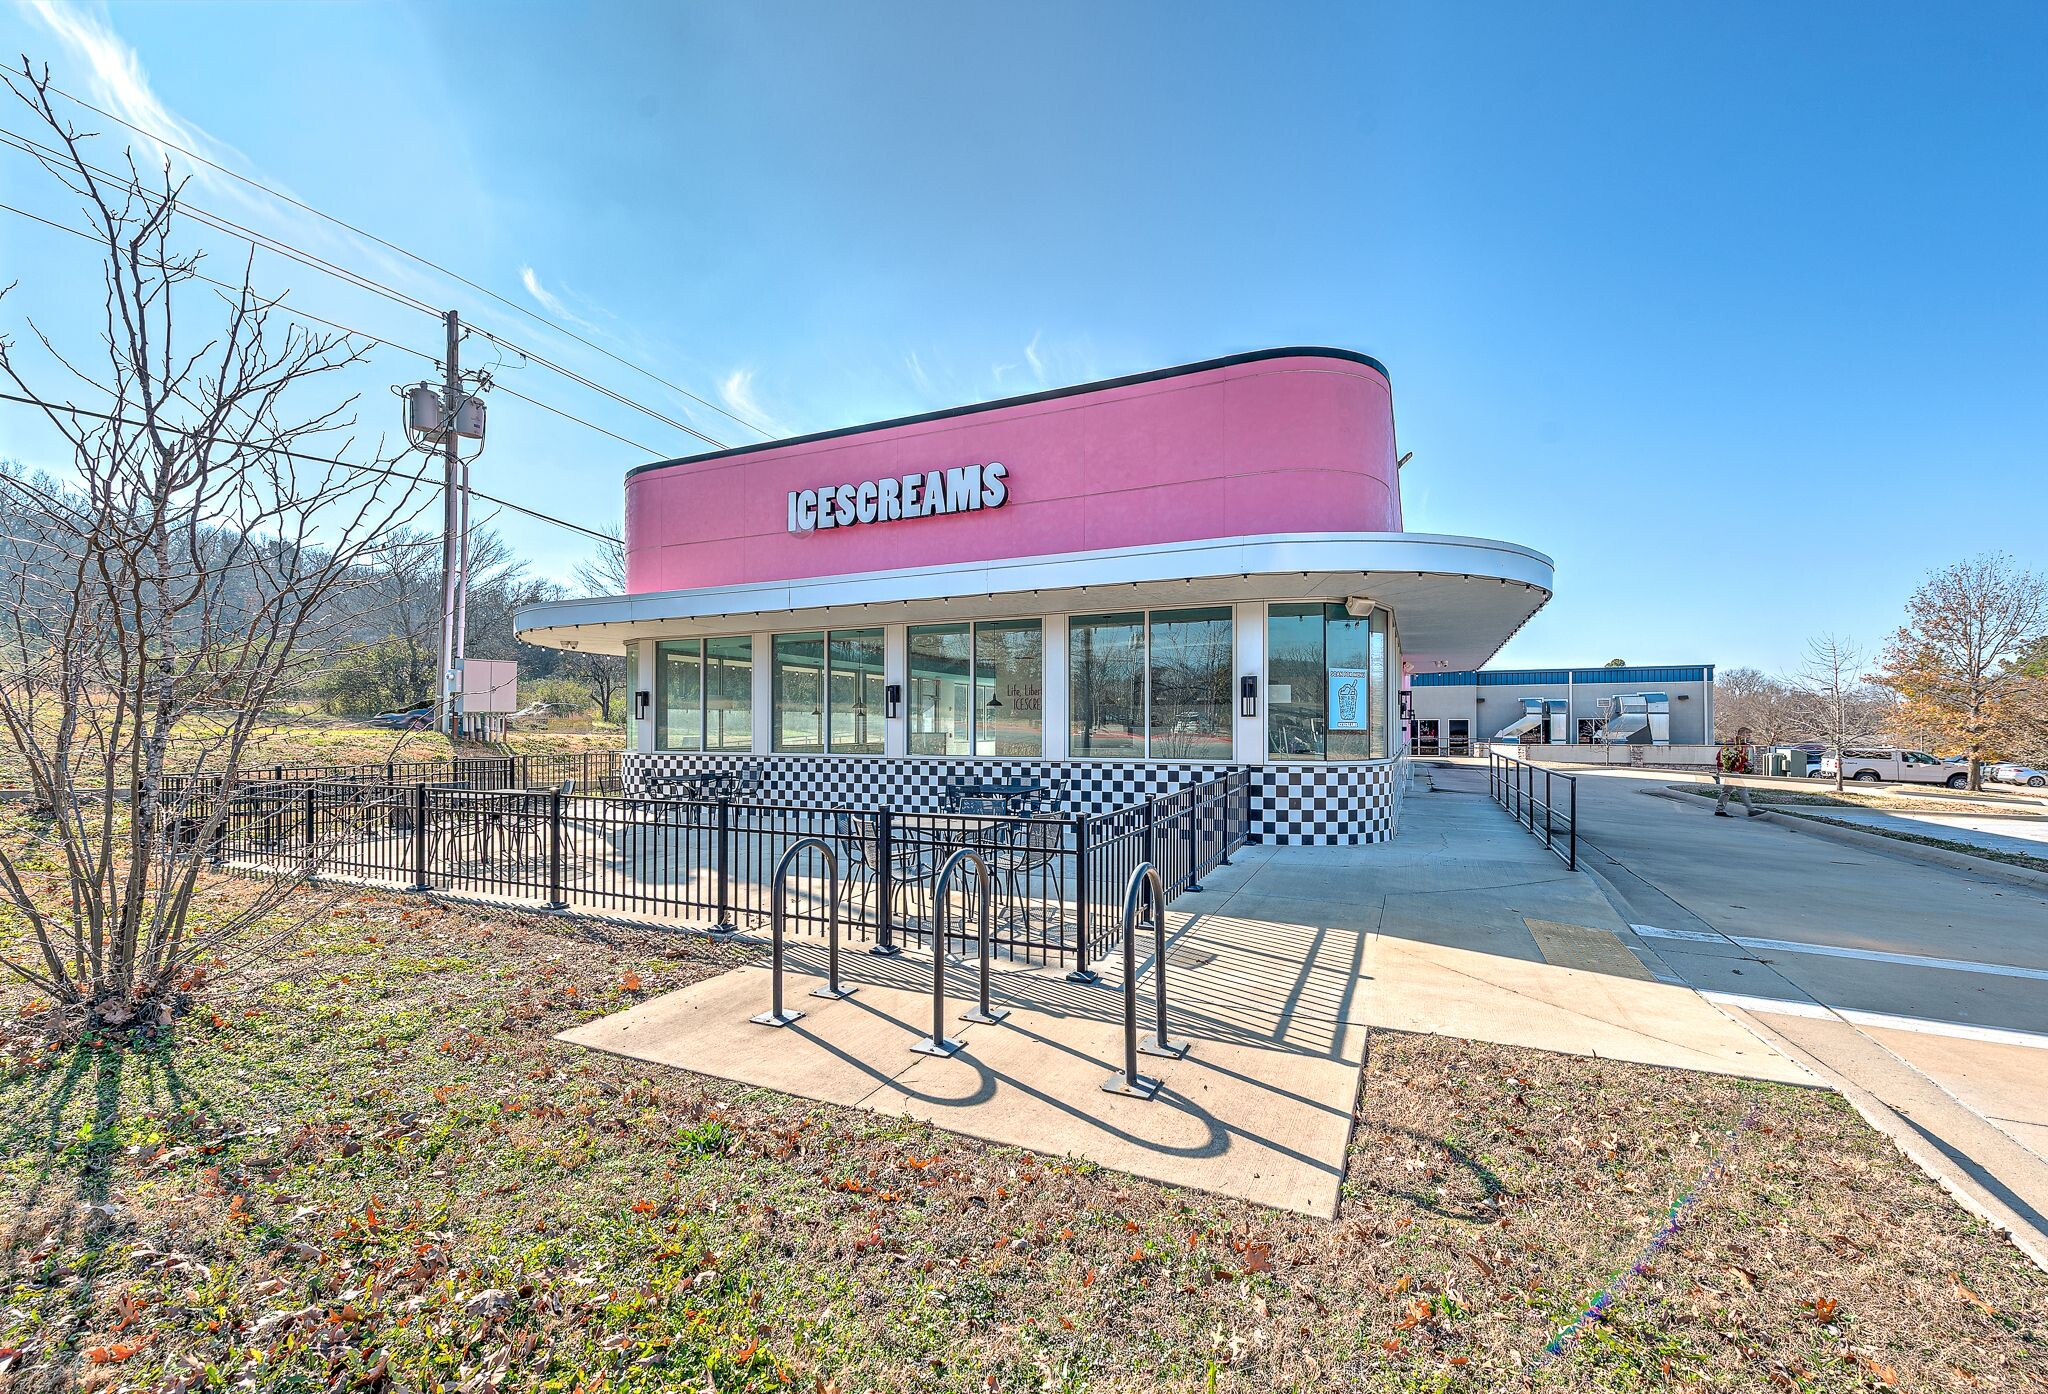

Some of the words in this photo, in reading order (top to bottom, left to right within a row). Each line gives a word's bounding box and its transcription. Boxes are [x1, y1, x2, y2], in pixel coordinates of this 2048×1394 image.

[787, 462, 1009, 533] ICESCREAMS
[1007, 684, 1021, 697] Life,
[1024, 684, 1042, 696] Liber
[1013, 697, 1041, 711] ICESCRE
